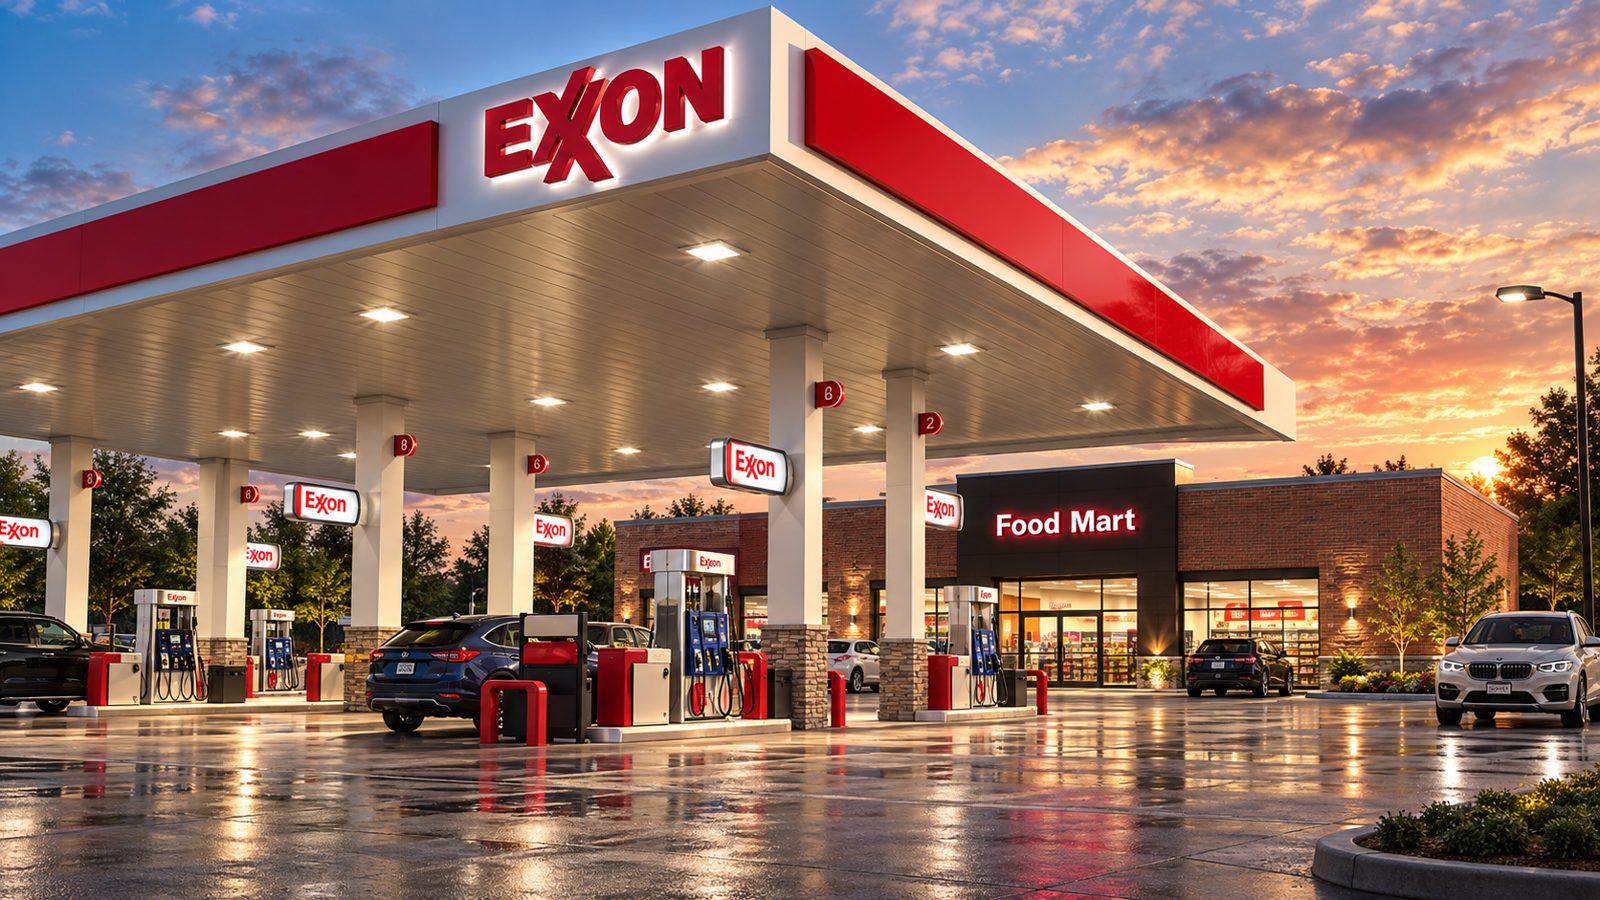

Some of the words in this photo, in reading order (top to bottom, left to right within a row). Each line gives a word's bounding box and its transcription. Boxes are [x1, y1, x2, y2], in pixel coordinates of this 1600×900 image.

[484, 45, 725, 185] EXXON
[926, 416, 934, 430] 2
[401, 438, 408, 451] 8
[534, 458, 541, 470] 6
[735, 449, 775, 480] Exxon
[305, 490, 347, 515] Exxon
[926, 495, 955, 520] Exxon
[0, 520, 39, 541] Exxon
[536, 518, 567, 540] Exxon
[996, 511, 1060, 537] Food
[1070, 508, 1136, 534] Mart
